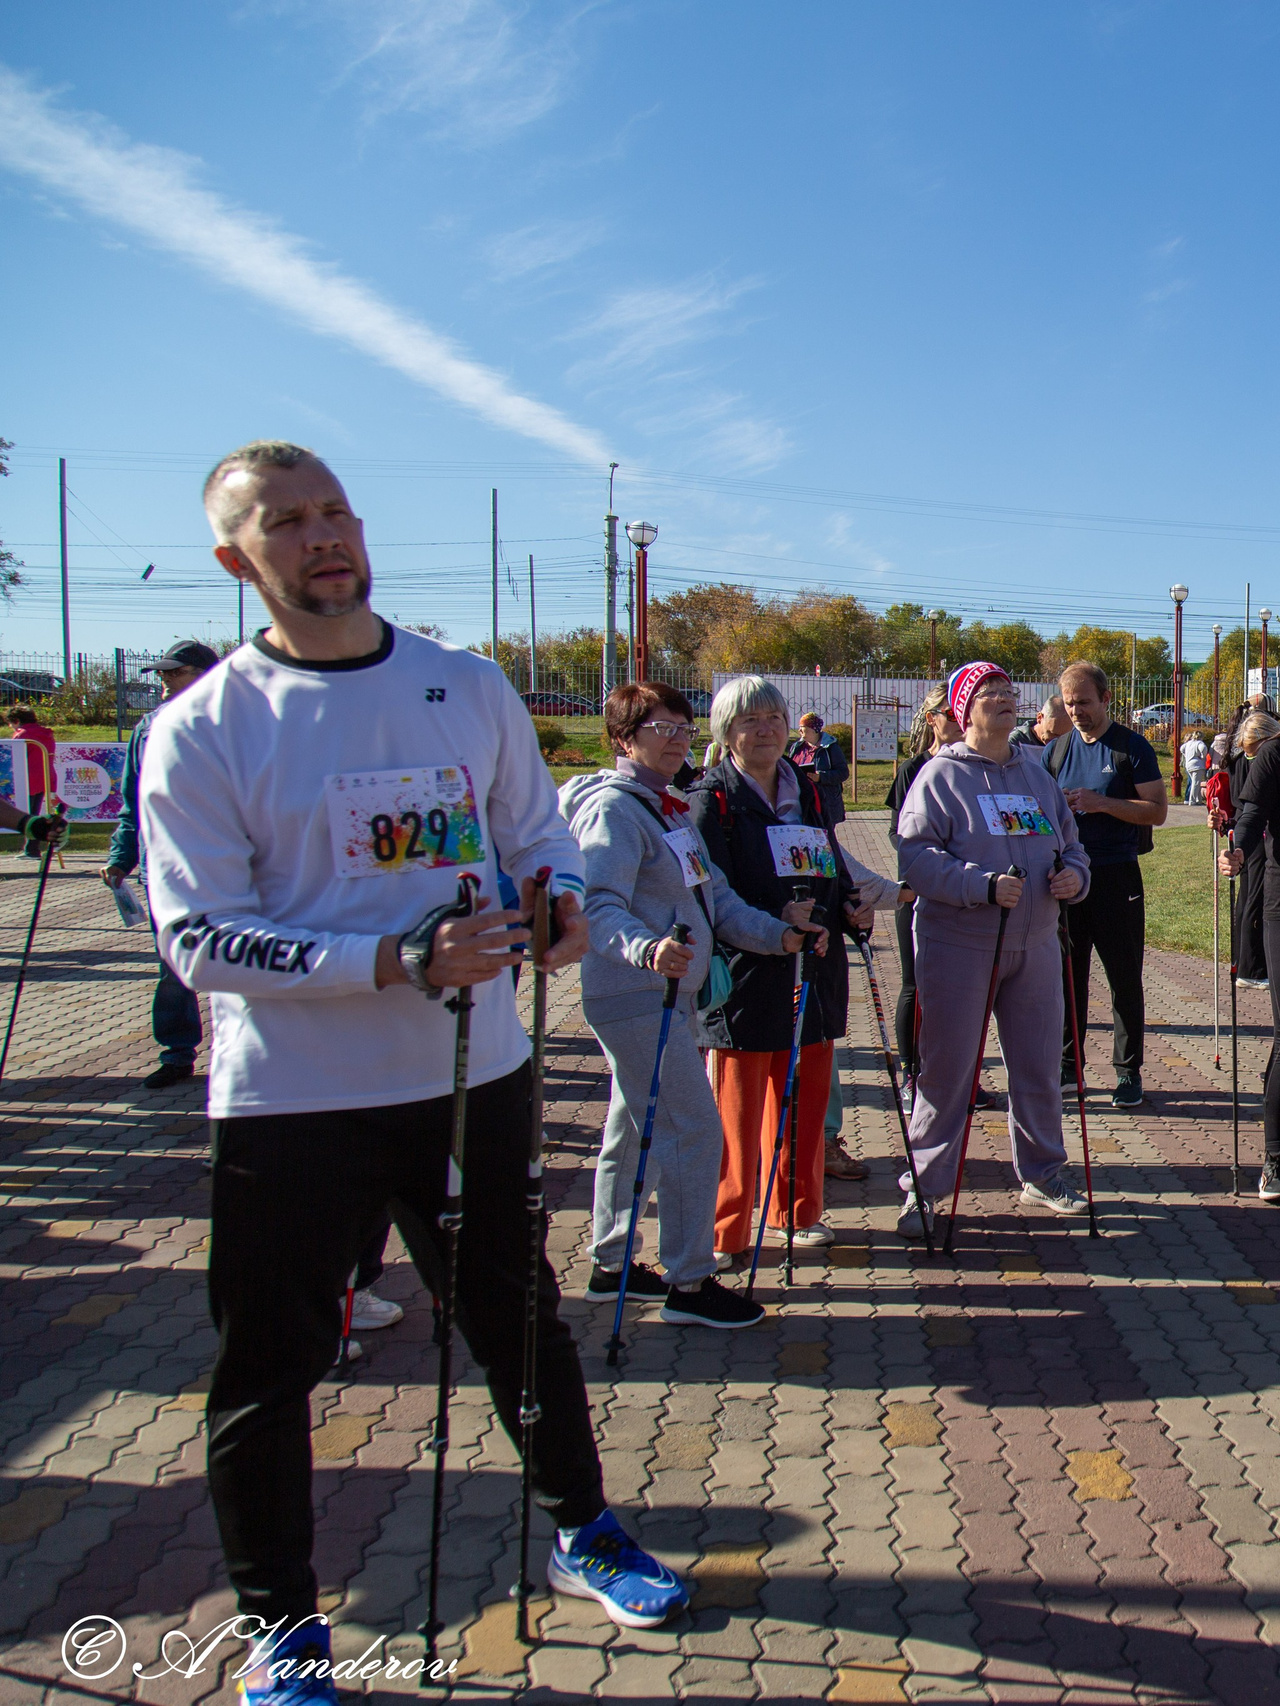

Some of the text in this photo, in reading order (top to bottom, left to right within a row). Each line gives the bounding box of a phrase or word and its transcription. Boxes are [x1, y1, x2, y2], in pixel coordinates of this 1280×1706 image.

[371, 808, 449, 862] 829
[1000, 810, 1036, 831] 813
[789, 846, 824, 870] 814
[203, 926, 317, 975] YONEX
